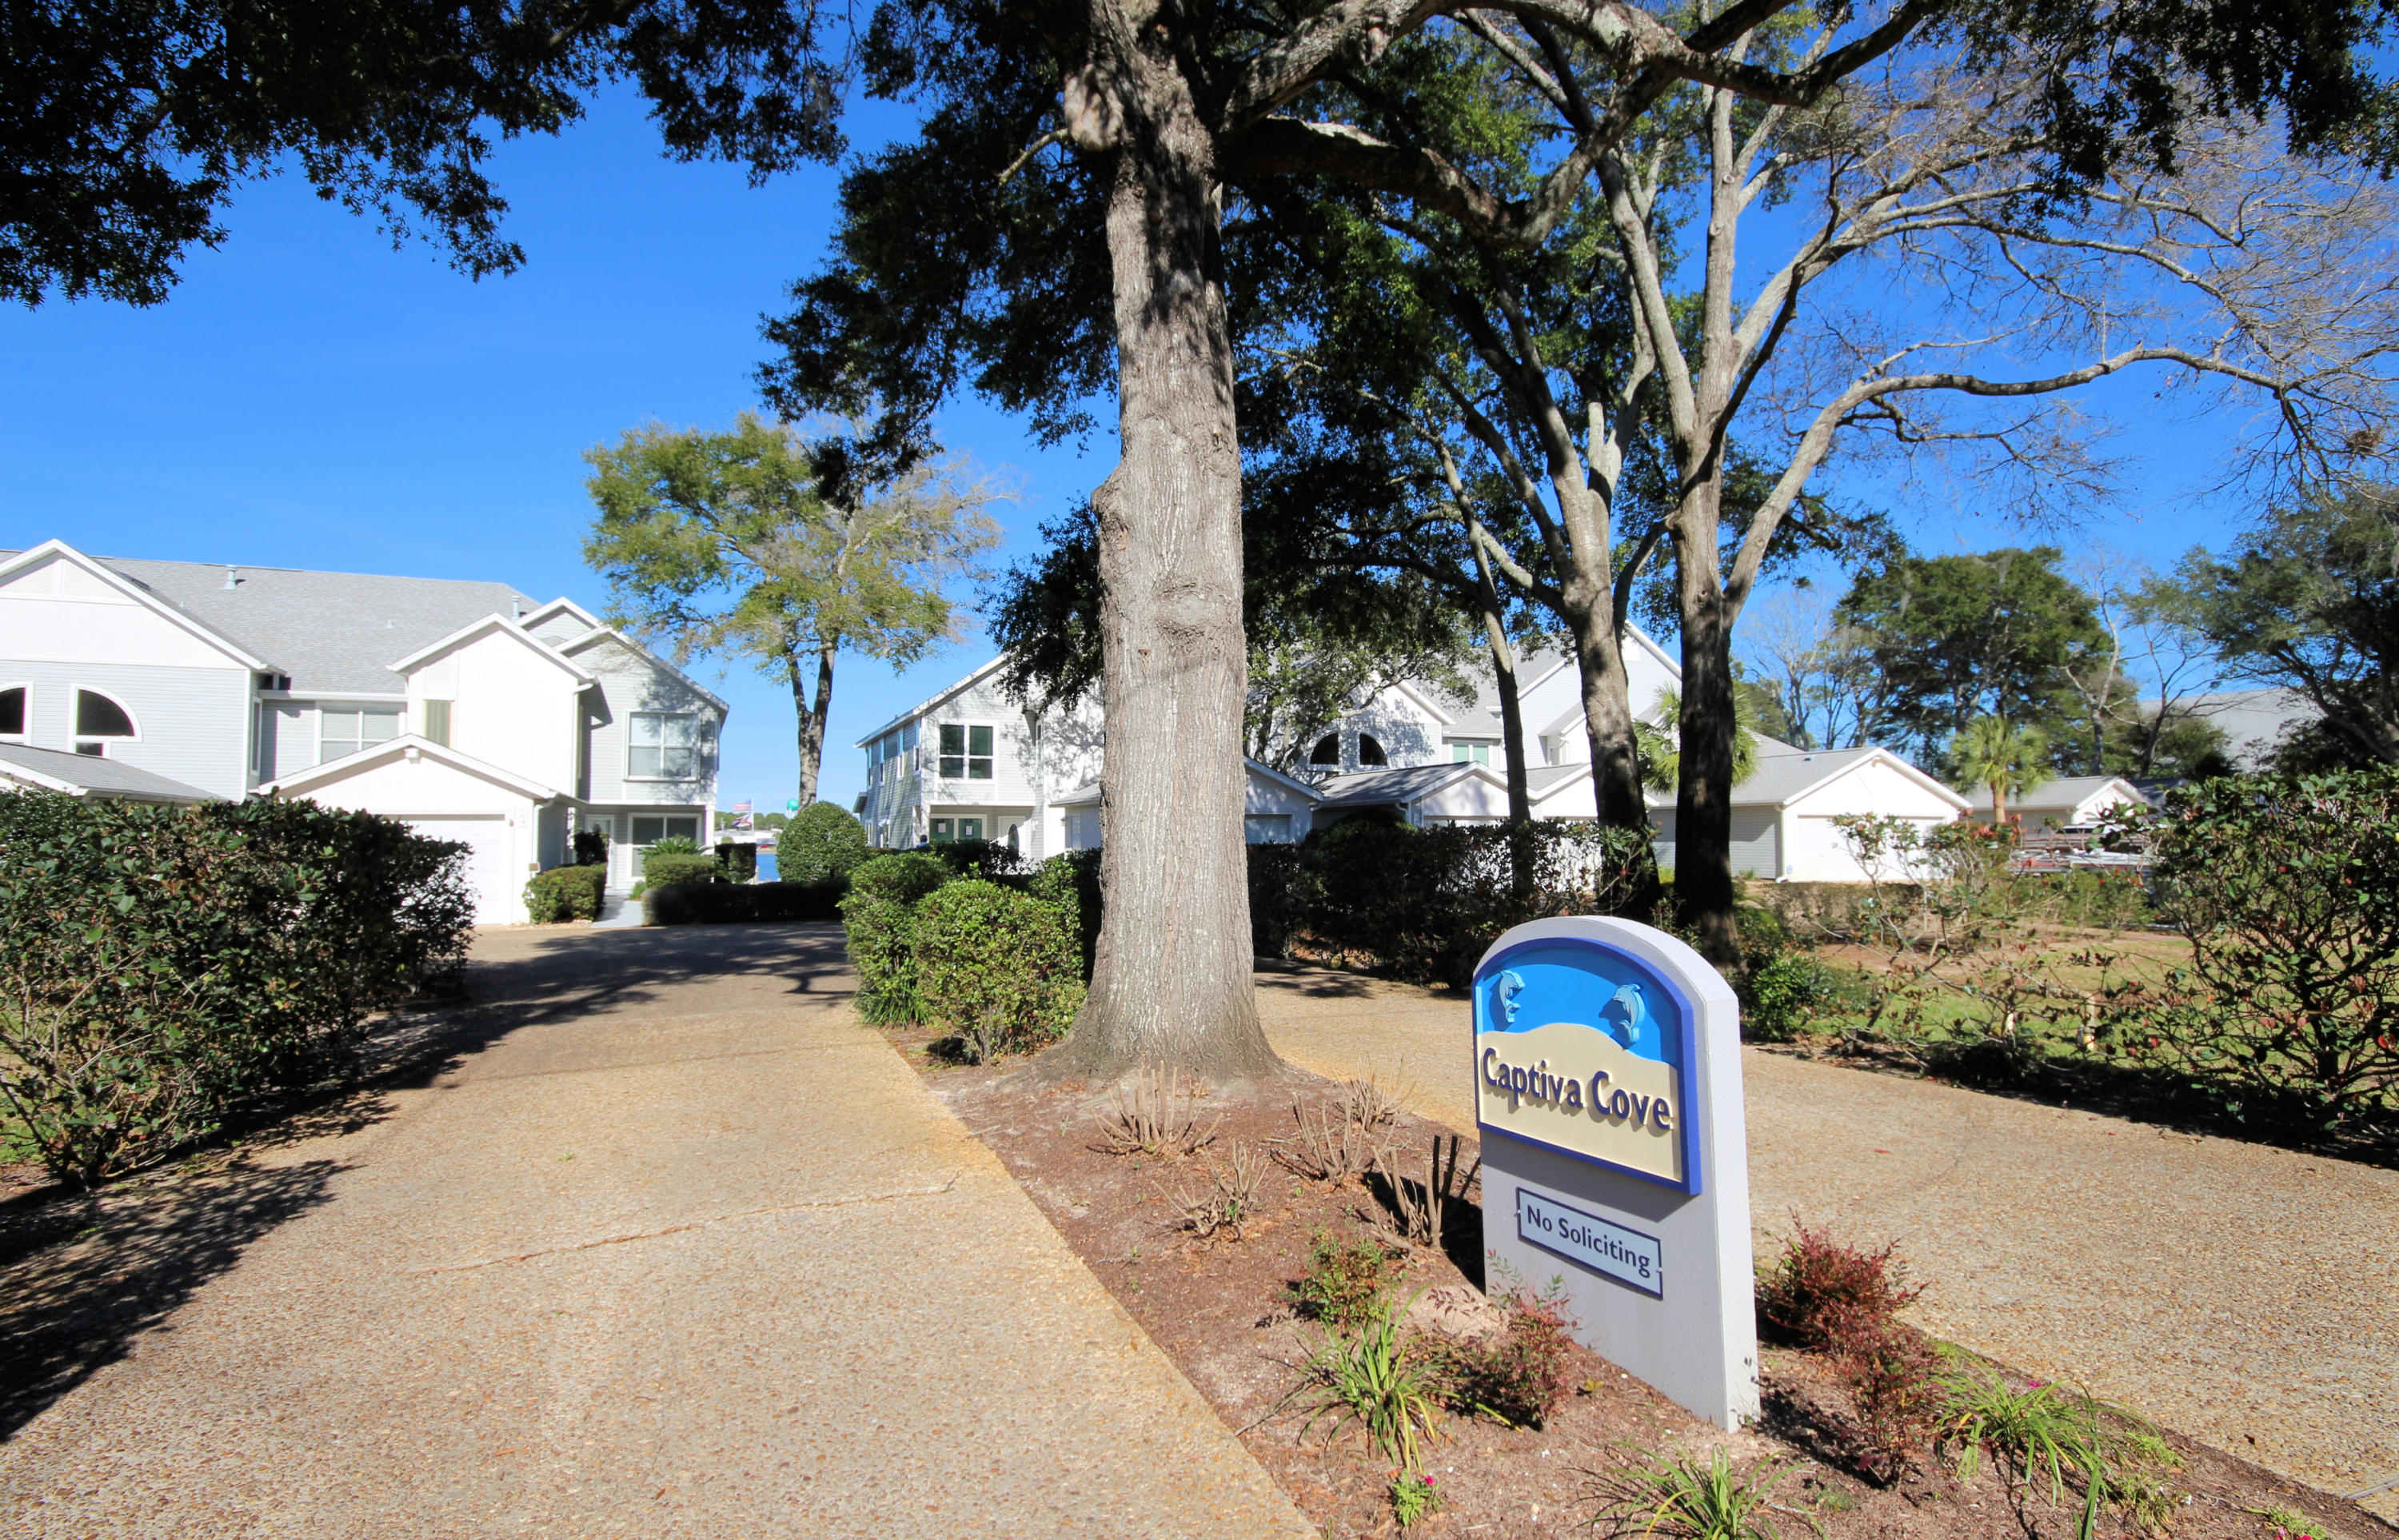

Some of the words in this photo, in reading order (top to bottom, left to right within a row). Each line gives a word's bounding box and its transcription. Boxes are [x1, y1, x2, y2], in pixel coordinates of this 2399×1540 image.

[1483, 1047, 1585, 1108] Captiva
[1592, 1071, 1671, 1130] Cove
[1527, 1204, 1552, 1231] No
[1559, 1218, 1651, 1279] Soliciting
